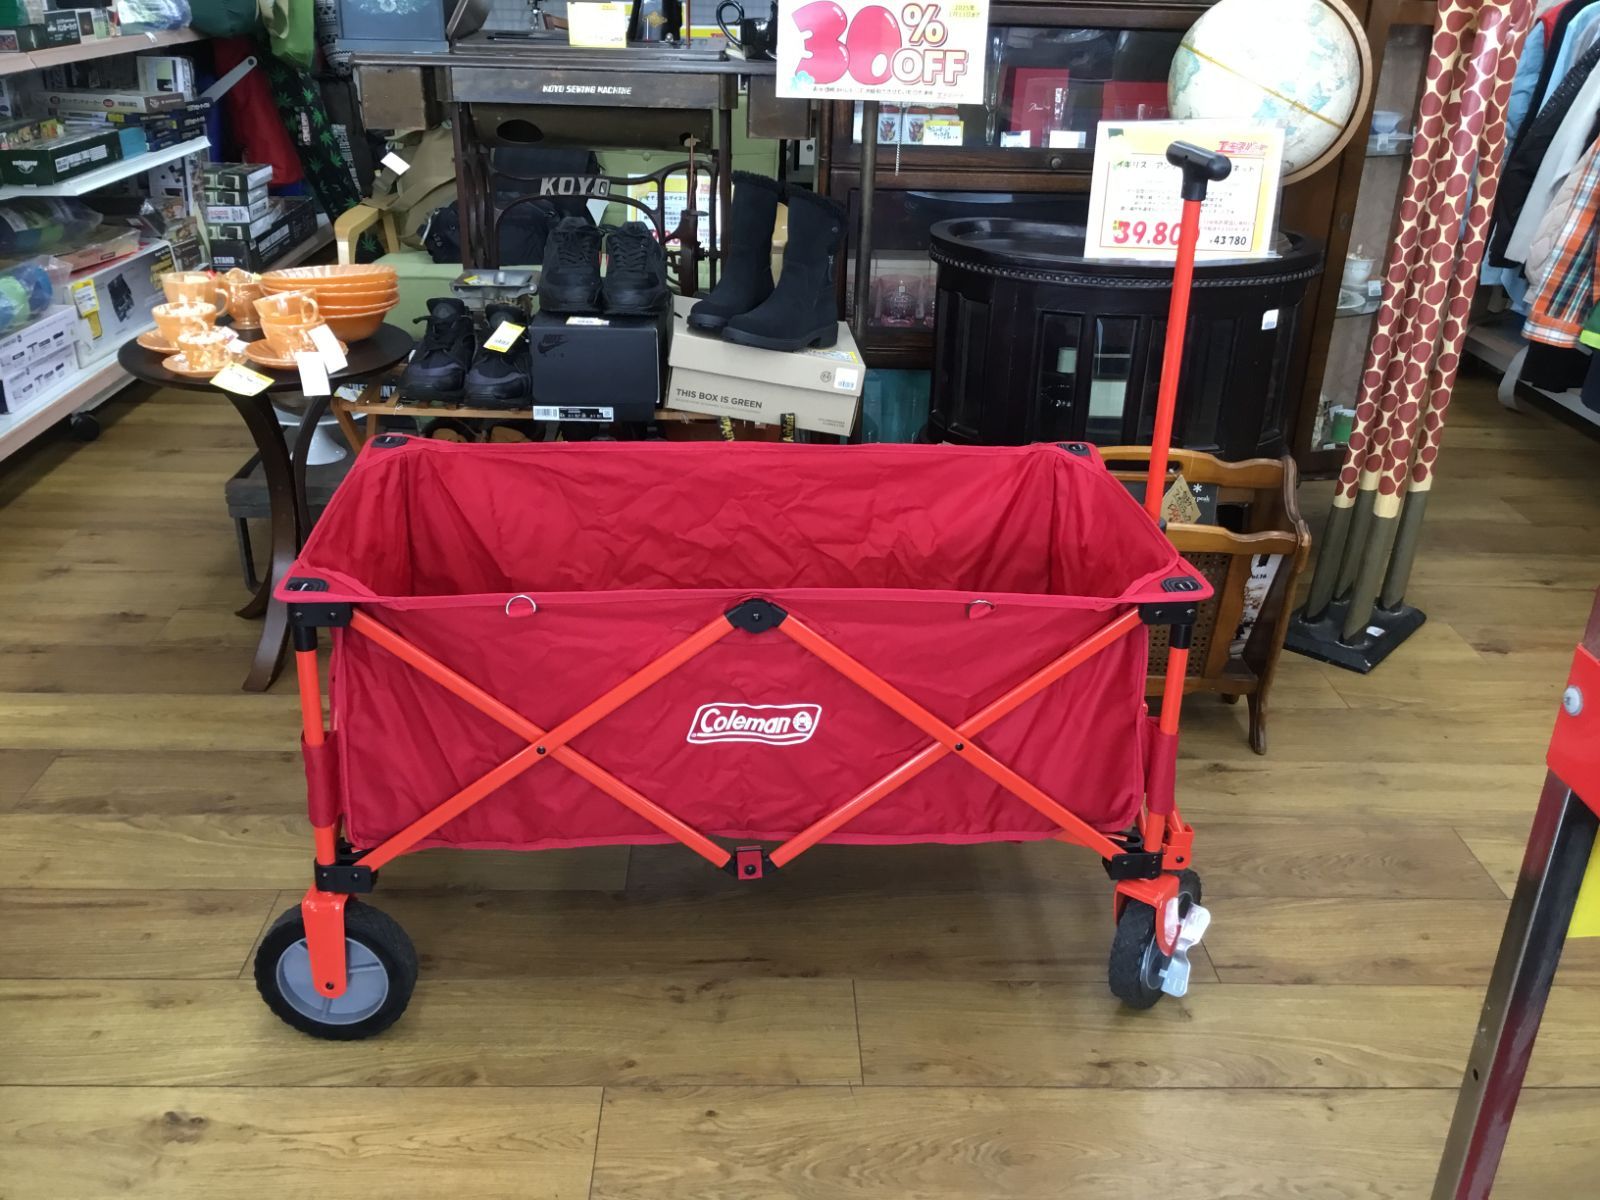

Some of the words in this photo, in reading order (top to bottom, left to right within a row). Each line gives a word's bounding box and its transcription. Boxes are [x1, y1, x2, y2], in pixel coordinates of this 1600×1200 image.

[892, 48, 969, 86] OFF
[566, 85, 596, 94] SEWING
[597, 85, 632, 95] MACHINE
[540, 177, 610, 196] KOYO
[676, 388, 697, 398] THIS
[698, 391, 719, 402] BOX
[720, 395, 729, 403] IS
[730, 397, 763, 408] GREEN
[700, 708, 791, 734] Coleman
